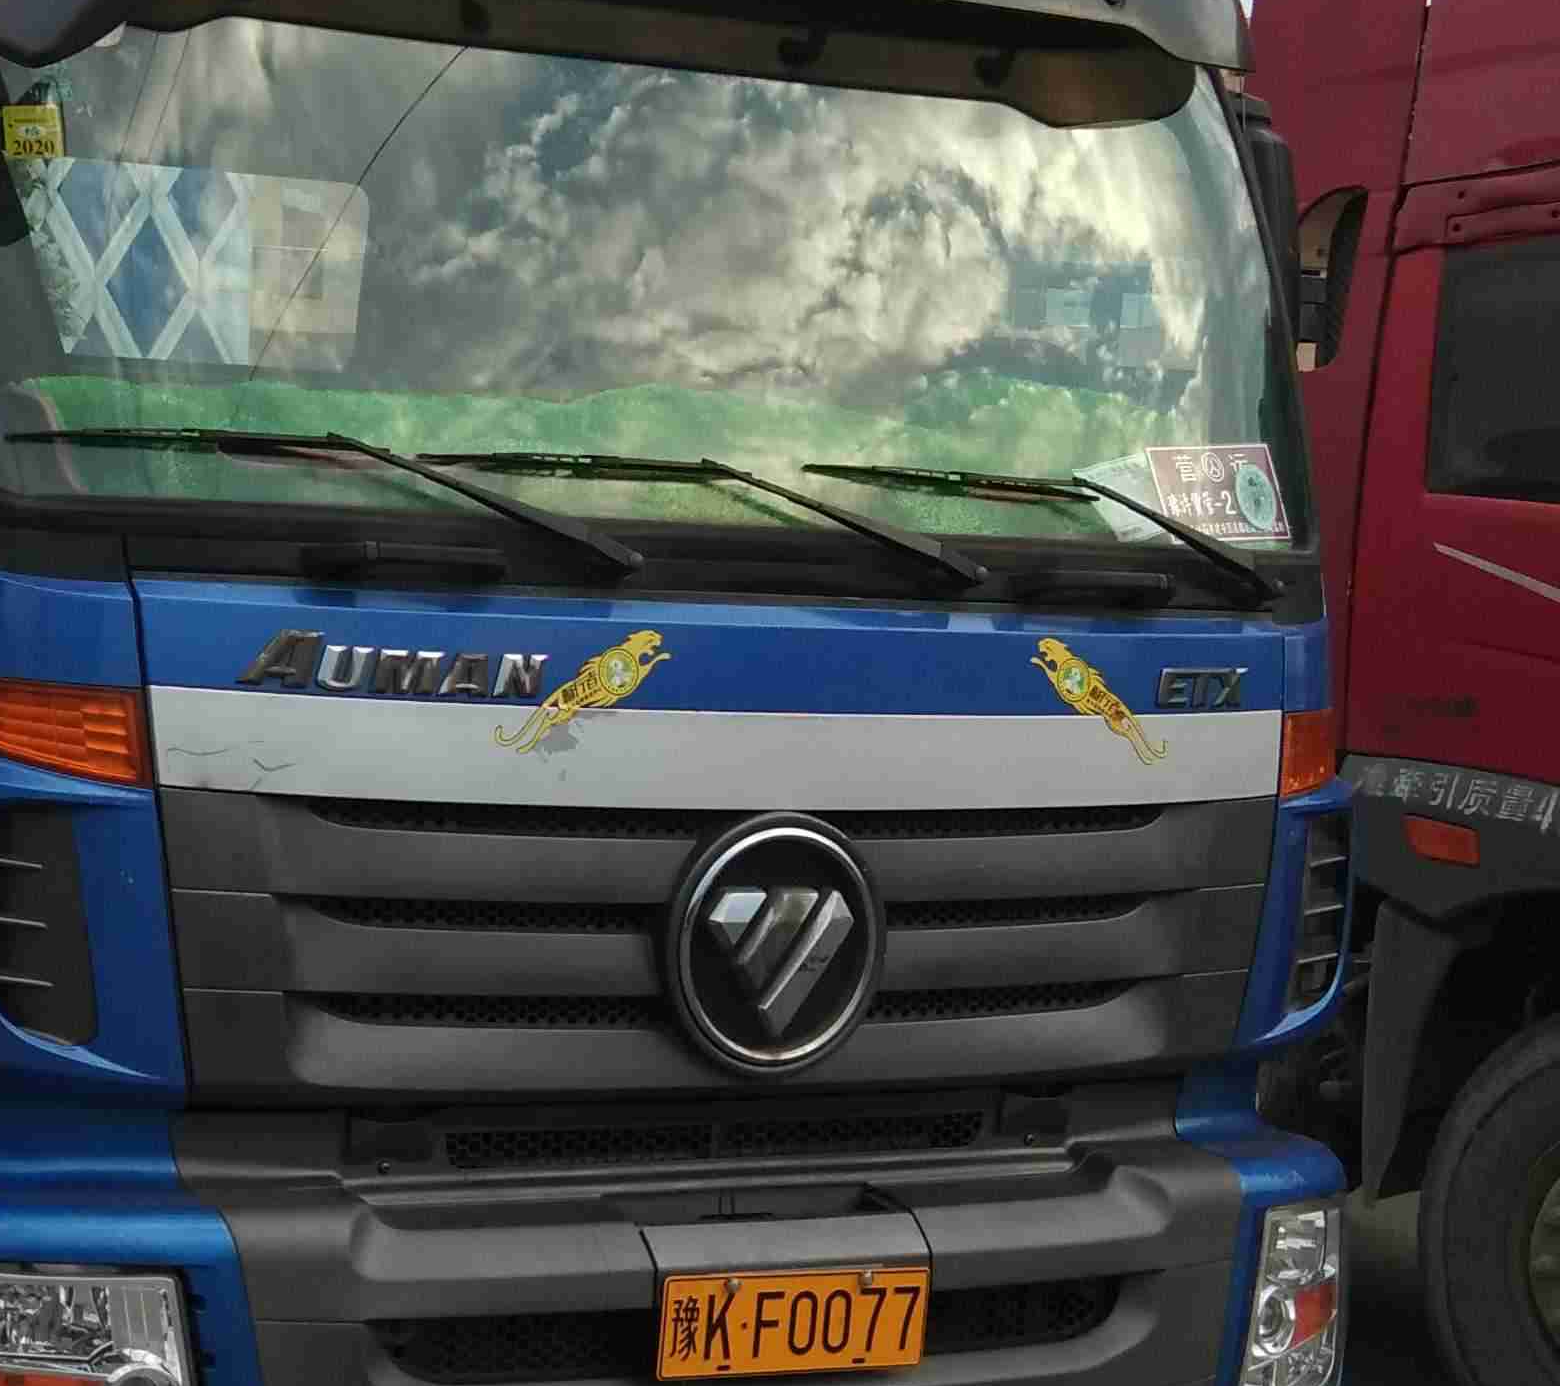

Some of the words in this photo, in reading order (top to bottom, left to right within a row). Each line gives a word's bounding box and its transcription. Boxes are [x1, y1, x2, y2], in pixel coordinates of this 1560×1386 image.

[13, 140, 56, 156] 2020
[235, 628, 552, 698] AUMAN
[1158, 667, 1249, 709] ETX
